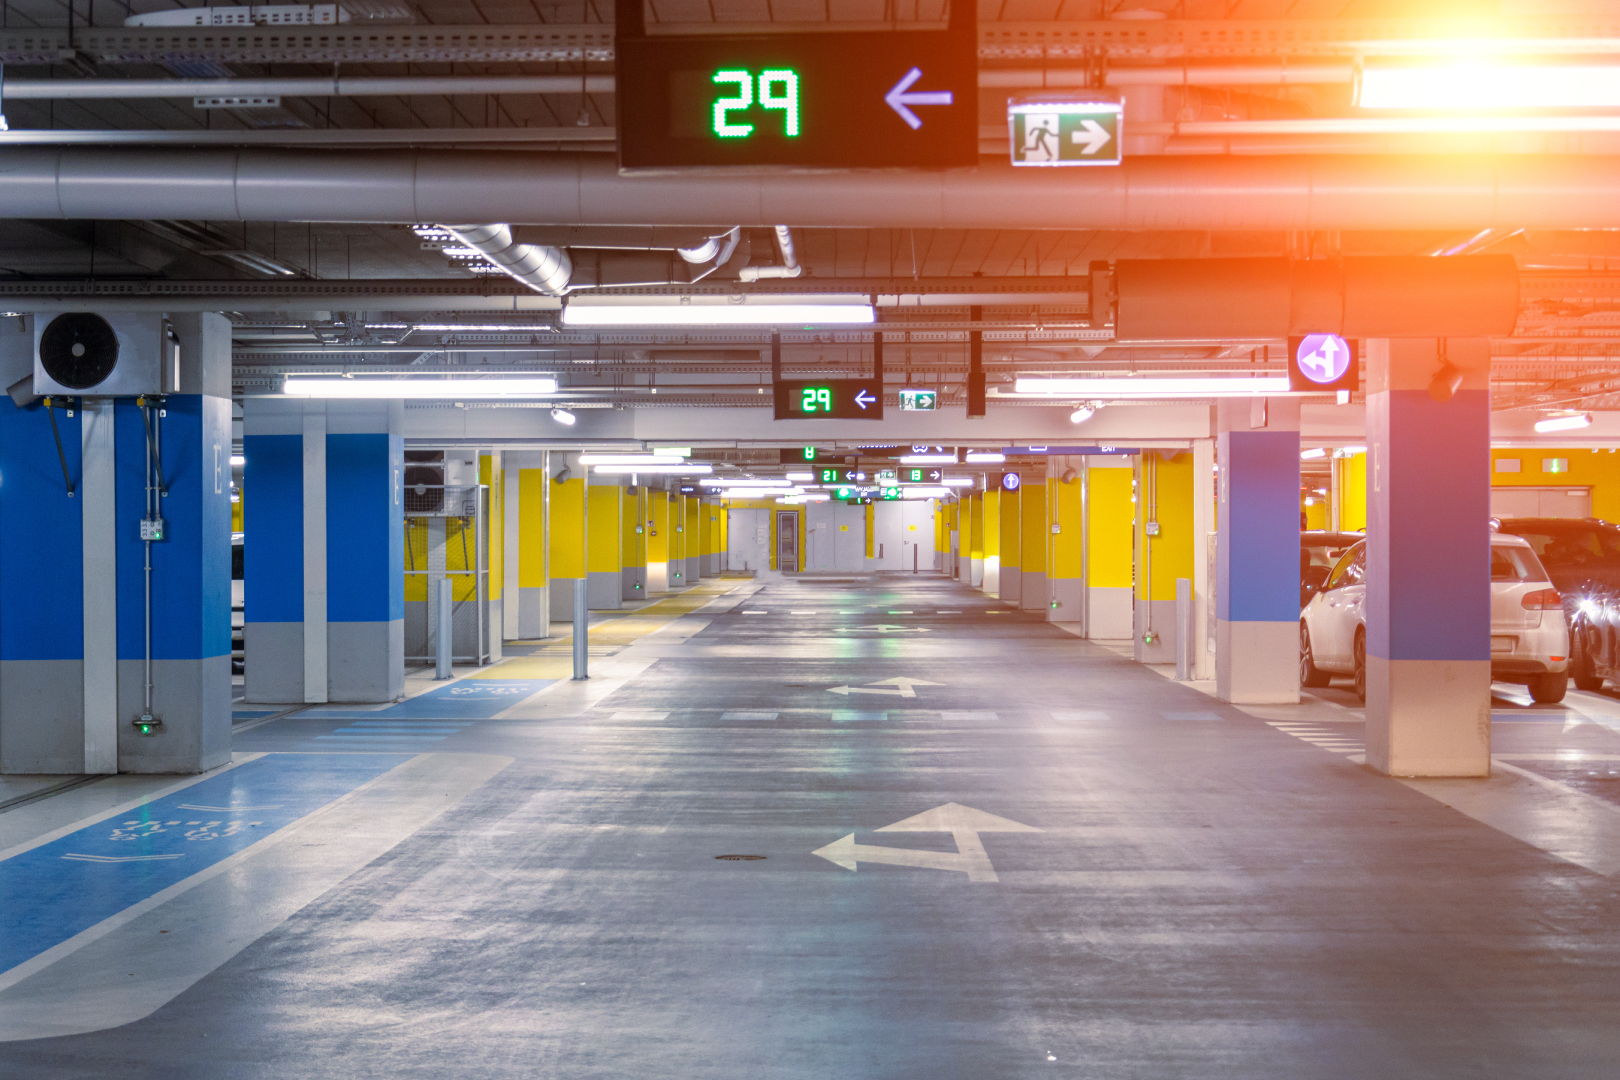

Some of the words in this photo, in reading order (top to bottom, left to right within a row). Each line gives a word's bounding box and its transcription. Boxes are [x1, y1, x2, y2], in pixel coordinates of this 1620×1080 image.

[713, 69, 799, 137] 29
[802, 388, 832, 412] 29
[213, 444, 222, 494] E
[823, 470, 837, 482] 21
[911, 469, 921, 481] 13
